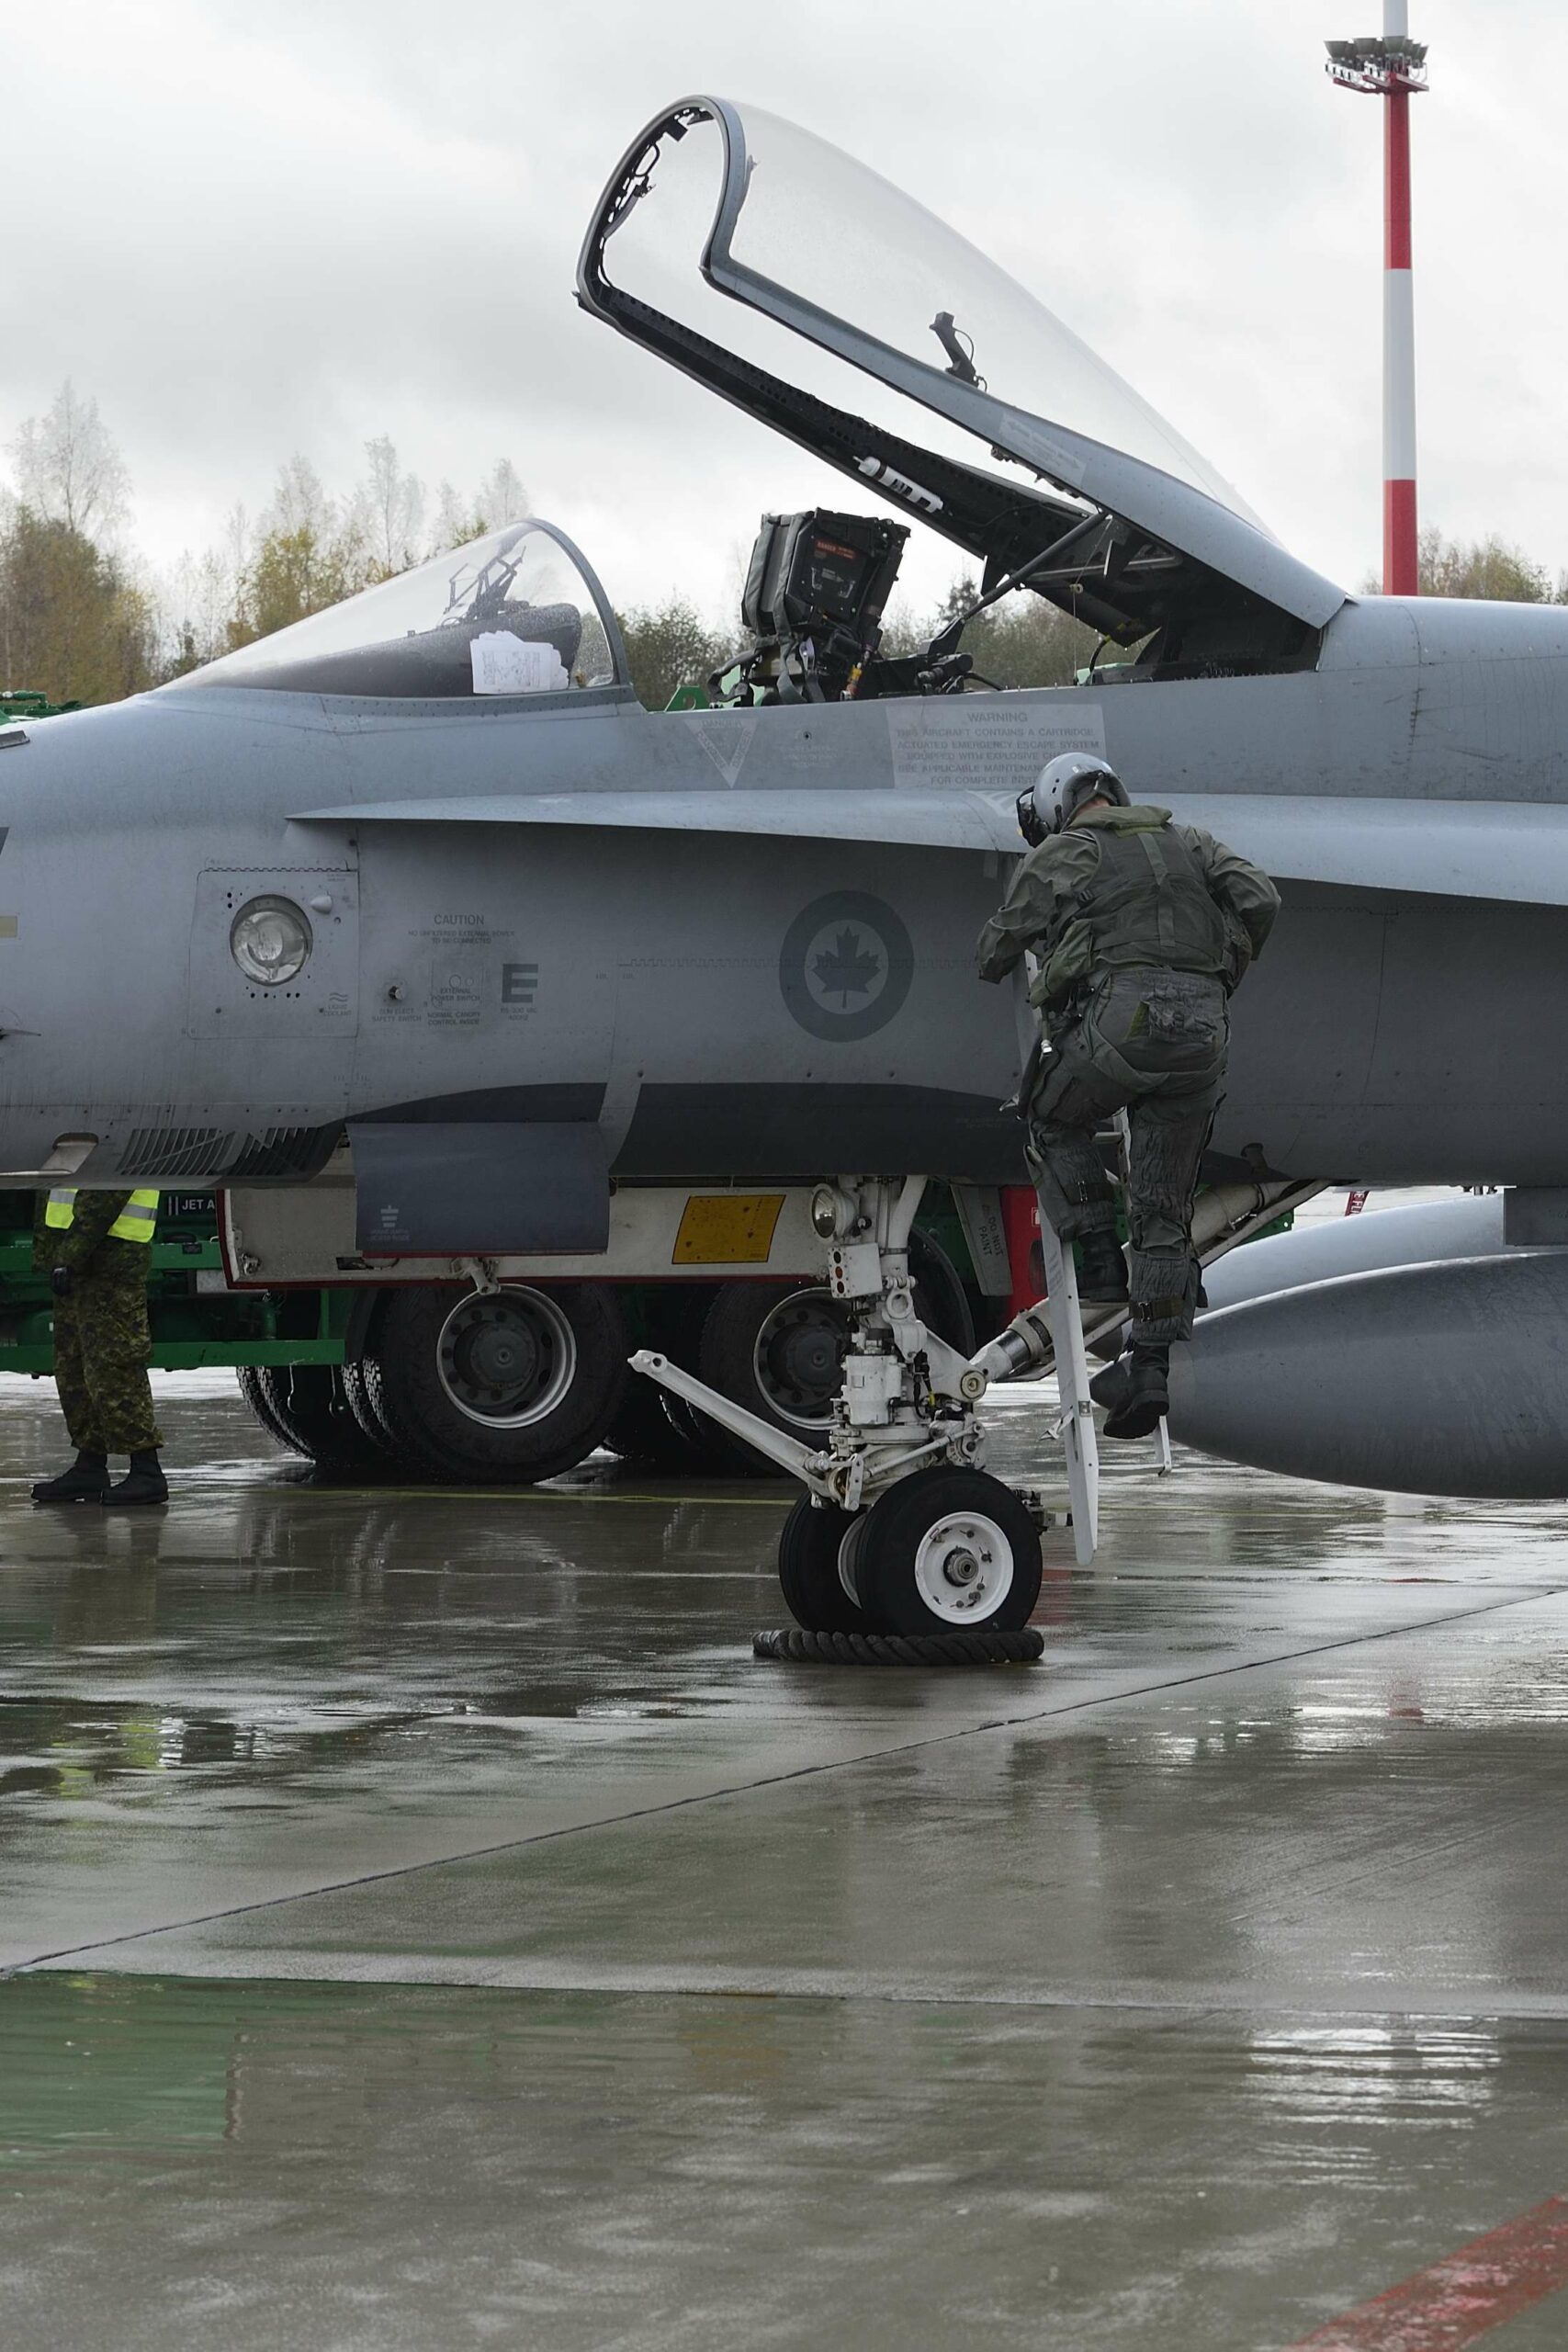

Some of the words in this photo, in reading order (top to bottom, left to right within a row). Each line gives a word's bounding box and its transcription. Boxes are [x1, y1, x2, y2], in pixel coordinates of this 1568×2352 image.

[967, 712, 1028, 722] WARNING
[922, 729, 970, 737] AIRCRAFT
[975, 728, 1024, 736] CONTAINS
[1028, 728, 1036, 736] A
[1039, 728, 1095, 736] CARTRIDGE
[897, 741, 948, 750] ACTUATED
[952, 741, 1012, 750] EMERGENCY
[1017, 741, 1055, 749] ESCAPE
[1060, 741, 1100, 749] SYSTEM
[987, 752, 1039, 760] EXPLOSIVE
[922, 764, 981, 773] APPLICABLE
[931, 776, 952, 785] FOR
[954, 776, 1008, 785] COMPLETE
[434, 914, 485, 925] CAUTION
[502, 963, 538, 1003] E
[182, 1199, 205, 1211] JET
[978, 1226, 992, 1256] PAINT
[992, 1234, 1003, 1255] NOT
